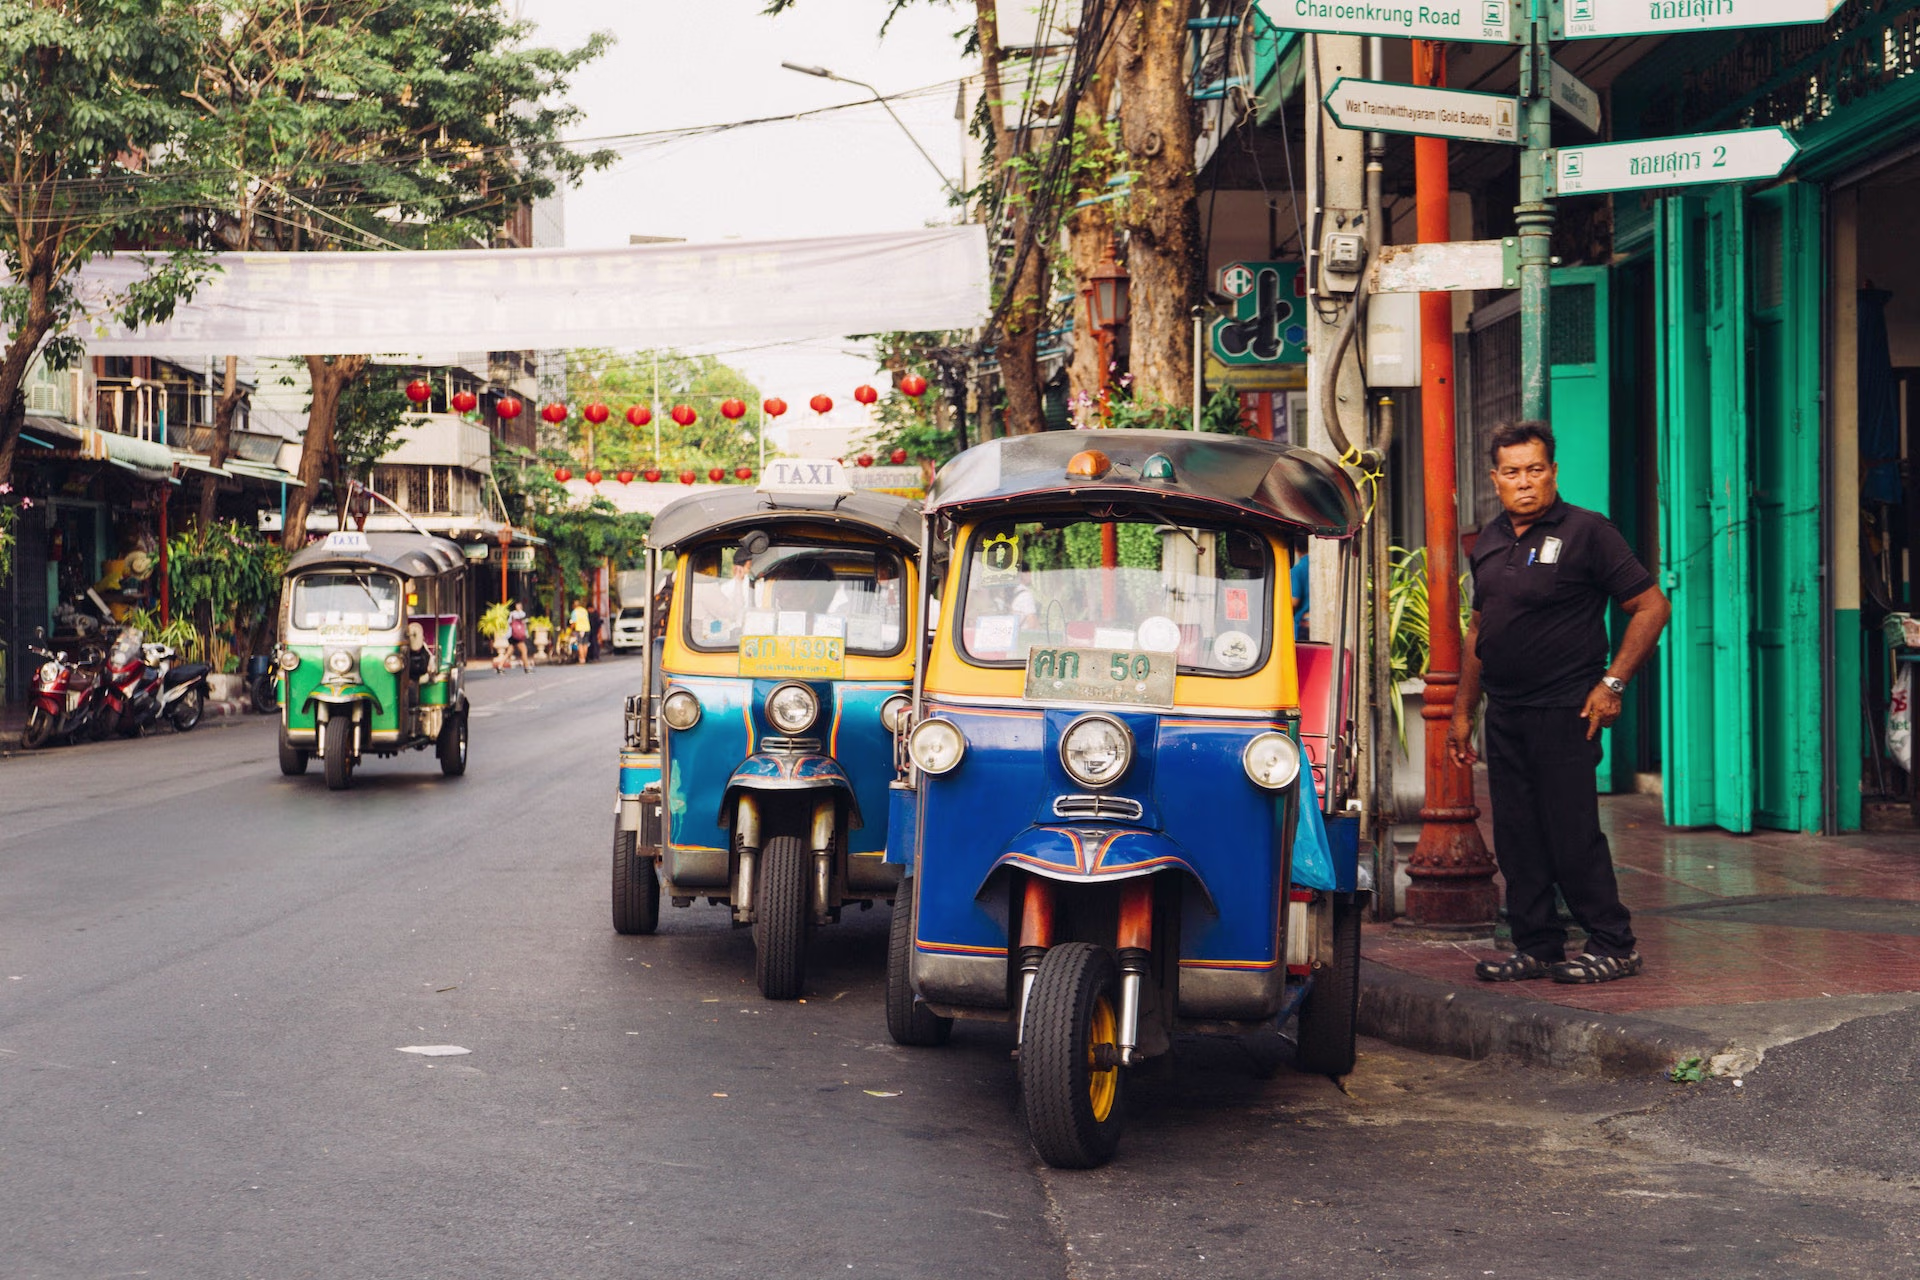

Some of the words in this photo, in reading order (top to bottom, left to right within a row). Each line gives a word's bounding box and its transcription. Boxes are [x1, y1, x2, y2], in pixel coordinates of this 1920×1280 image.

[1296, 0, 1412, 27] Charoenkrung
[1419, 6, 1460, 25] Road
[1483, 28, 1493, 37] 50
[1570, 24, 1587, 33] 100
[1345, 100, 1361, 112] Wat
[1438, 109, 1458, 124] (Gold
[1461, 112, 1491, 129] Buddha)
[1630, 151, 1701, 178] ซอยสุกร
[1712, 145, 1727, 168] 2
[775, 464, 835, 485] TAXI
[333, 536, 360, 546] TAXI
[789, 640, 840, 661] 1398
[1035, 649, 1080, 679] ศก
[1110, 652, 1150, 681] 50
